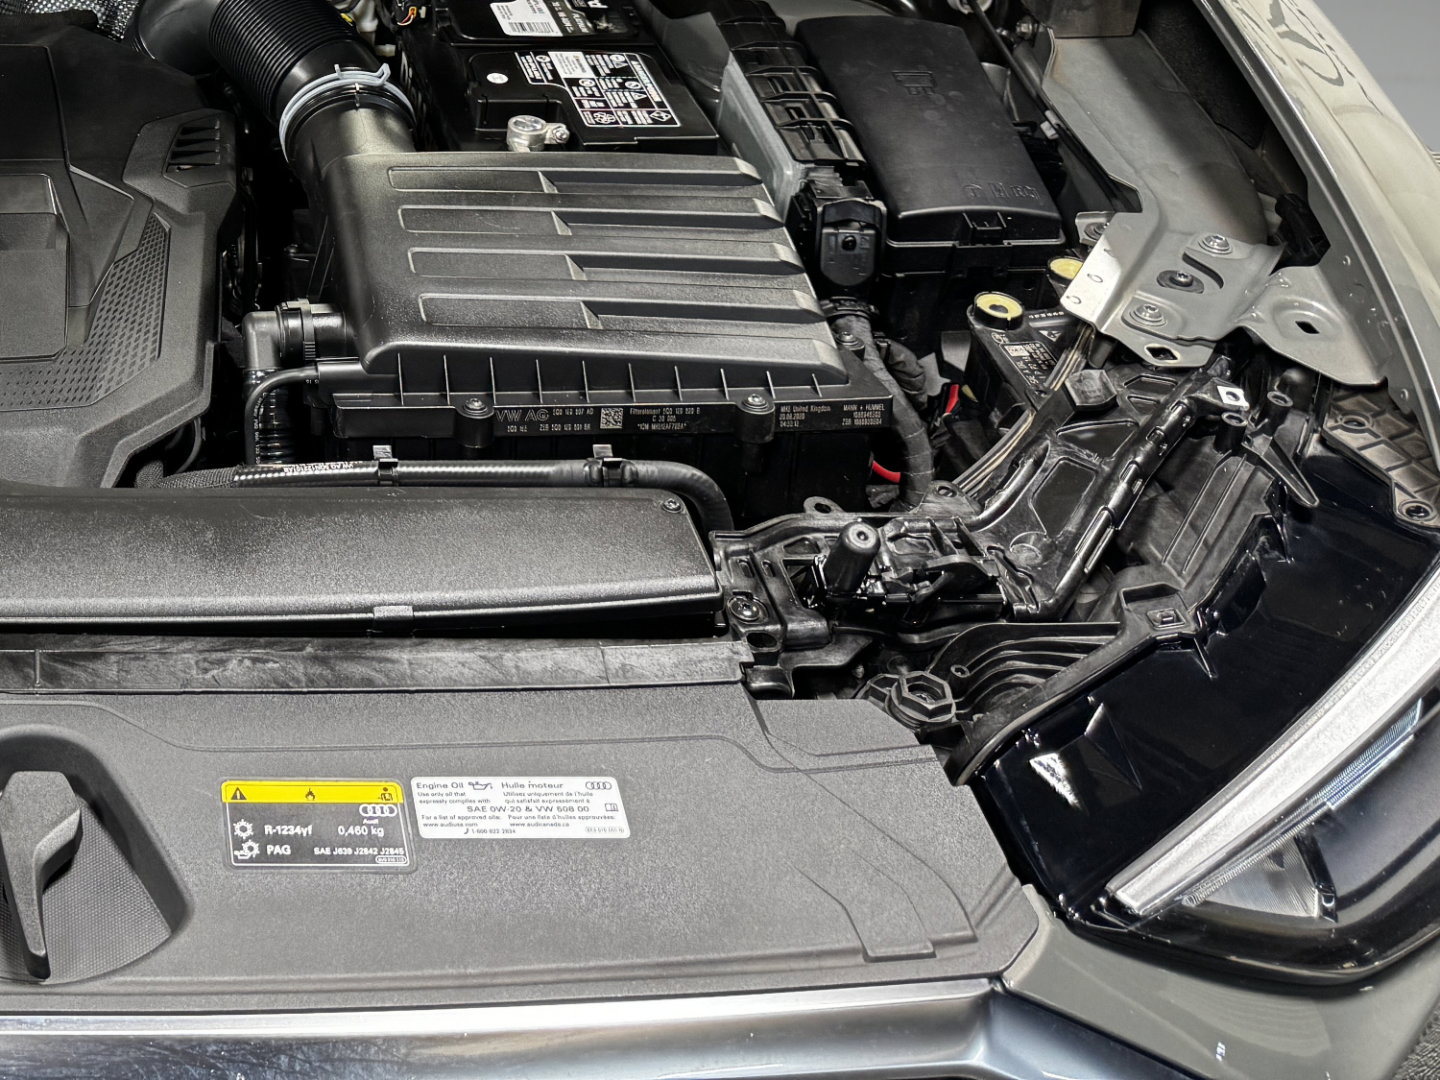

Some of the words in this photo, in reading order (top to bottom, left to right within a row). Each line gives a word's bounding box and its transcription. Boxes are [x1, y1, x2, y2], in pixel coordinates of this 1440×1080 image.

[793, 405, 809, 413] United
[496, 409, 522, 422] VW
[524, 409, 549, 422] AG
[416, 782, 448, 790] Engine
[467, 805, 488, 813] SAE
[490, 805, 522, 813] 0W-20
[264, 825, 313, 837] R-1234yf
[371, 825, 385, 837] kg
[266, 845, 291, 855] PAG
[314, 847, 332, 855] SAE
